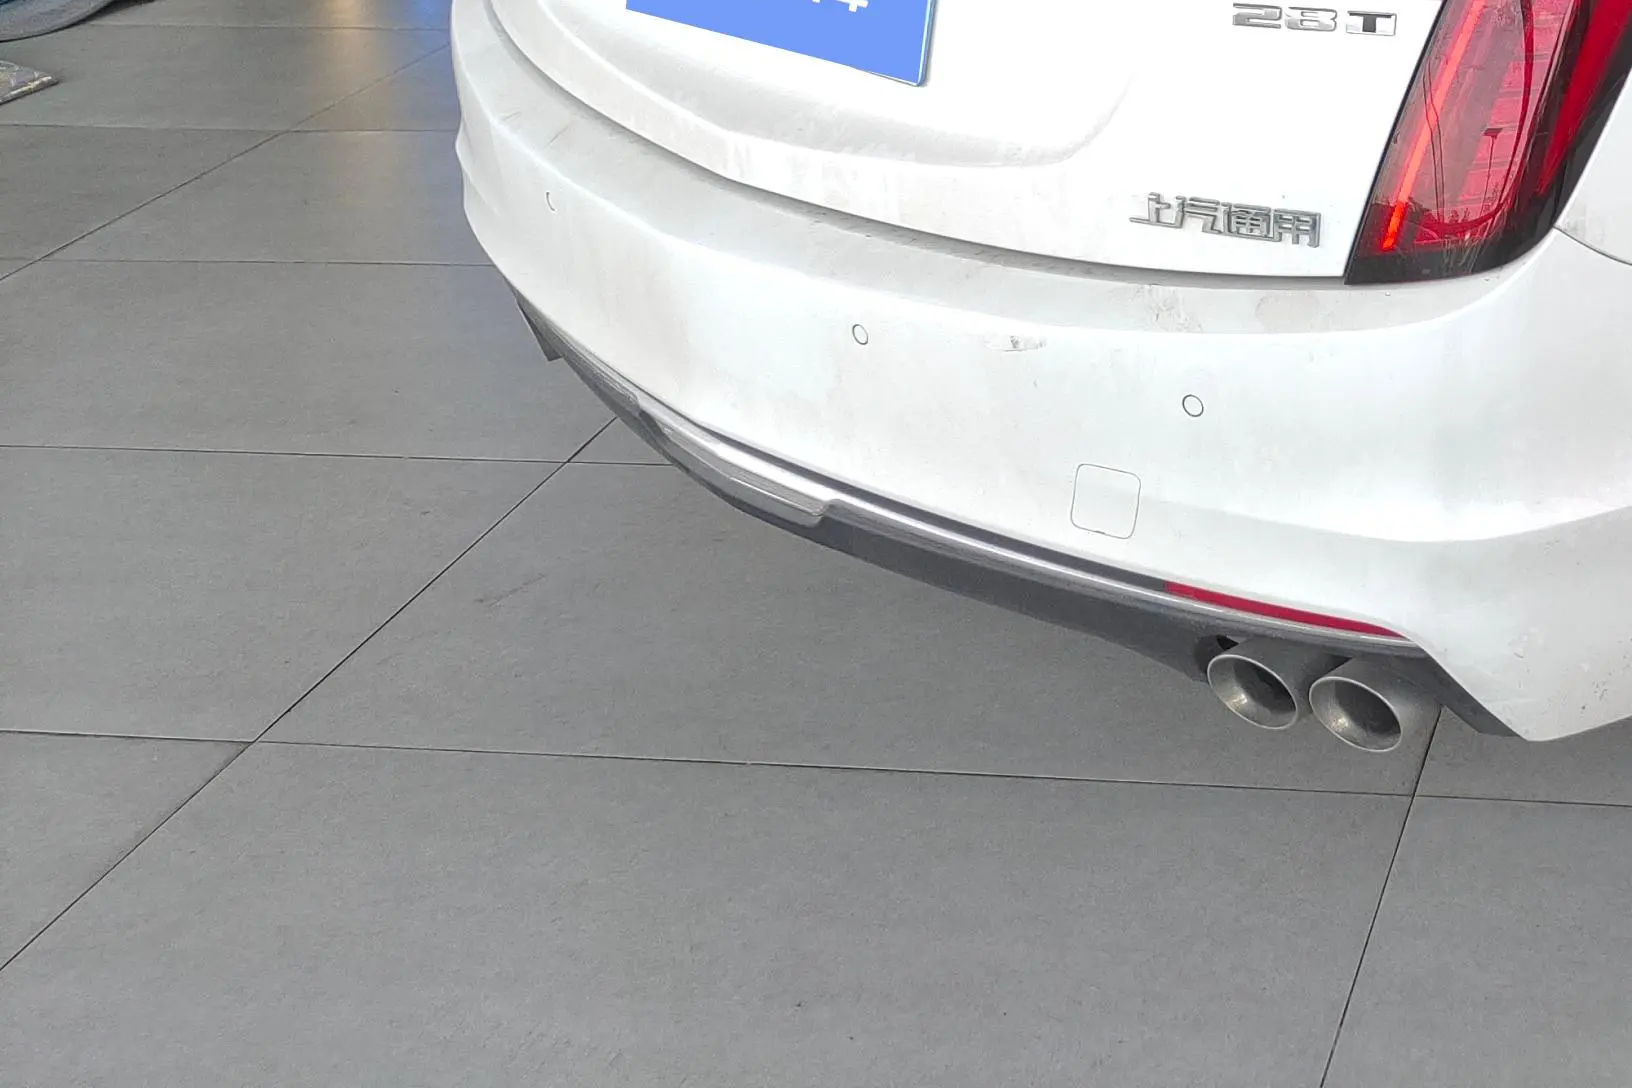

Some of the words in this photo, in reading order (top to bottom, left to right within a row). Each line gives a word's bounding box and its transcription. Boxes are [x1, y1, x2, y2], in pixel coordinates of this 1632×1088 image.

[1232, 2, 1397, 36] 28T
[1129, 191, 1322, 248] 上汽通用
